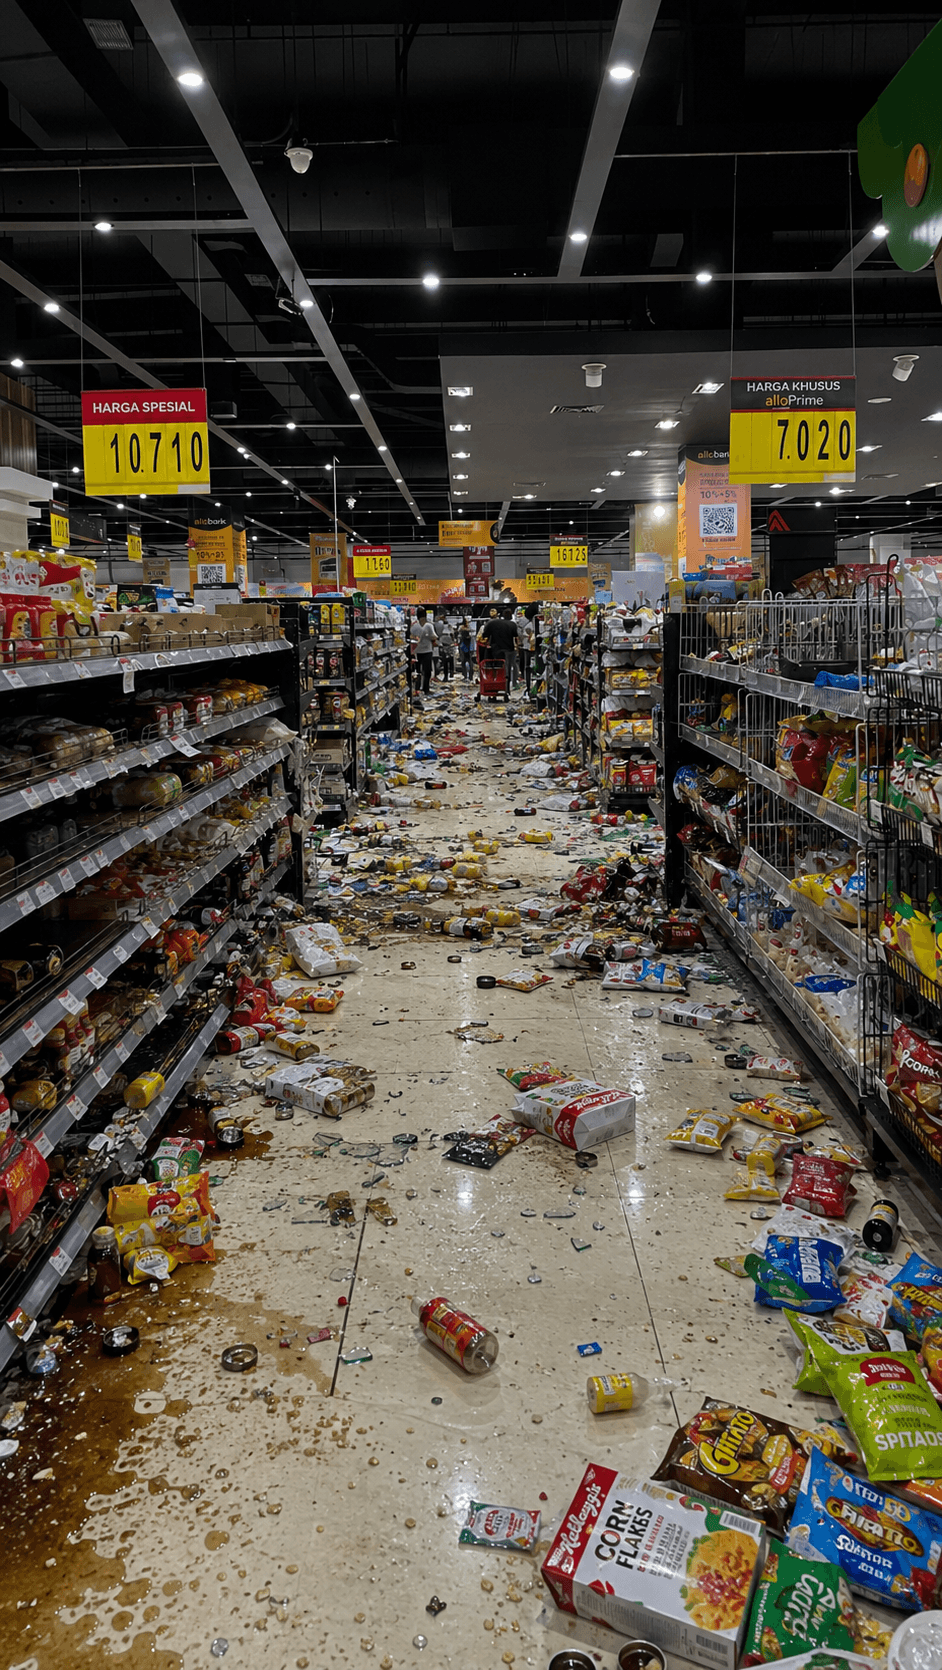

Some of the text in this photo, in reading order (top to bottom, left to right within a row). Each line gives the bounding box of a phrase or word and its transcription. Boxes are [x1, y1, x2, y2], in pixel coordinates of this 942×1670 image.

[746, 381, 841, 392] HARGA KHUSUS
[765, 394, 824, 406] alloPrime
[92, 401, 196, 413] HARGA SPESIAL
[110, 431, 203, 473] 10.710
[777, 418, 851, 461] 7.020
[594, 1499, 634, 1562] CORN
